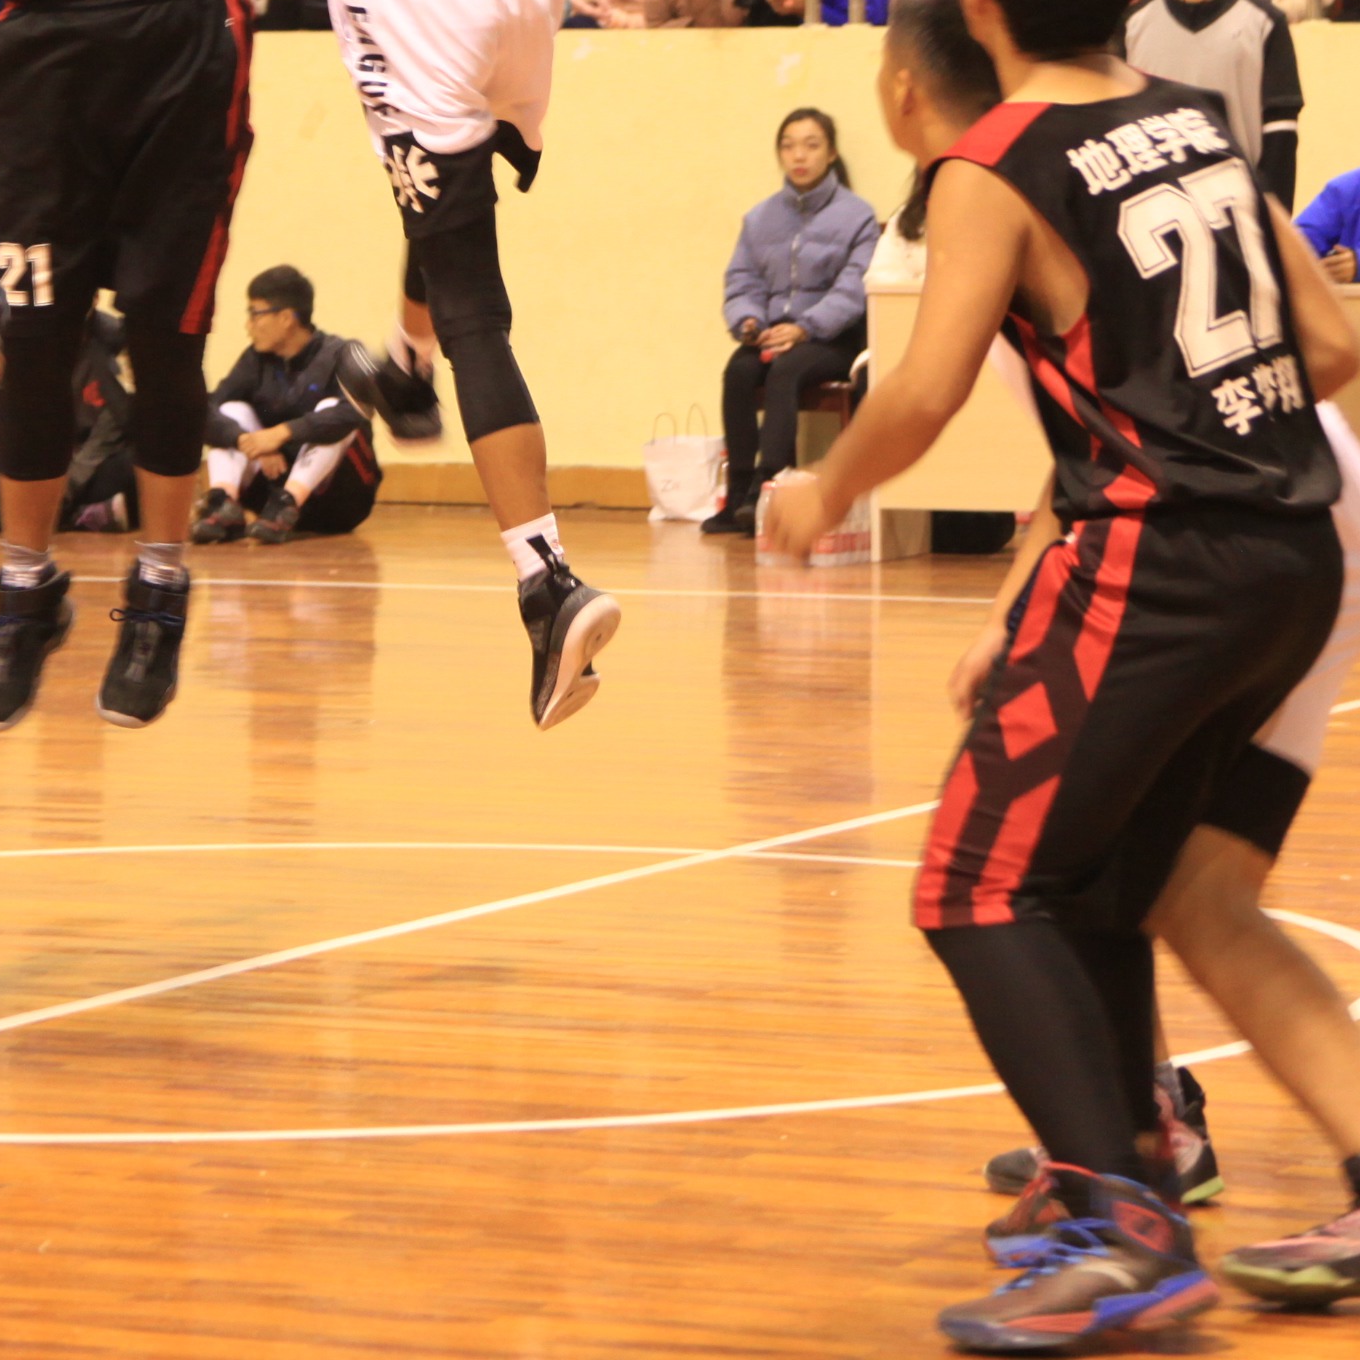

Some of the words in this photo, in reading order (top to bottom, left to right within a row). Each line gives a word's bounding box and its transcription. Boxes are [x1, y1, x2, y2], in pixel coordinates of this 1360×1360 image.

[1066, 108, 1230, 195] 地理学院
[1117, 158, 1283, 378] 27
